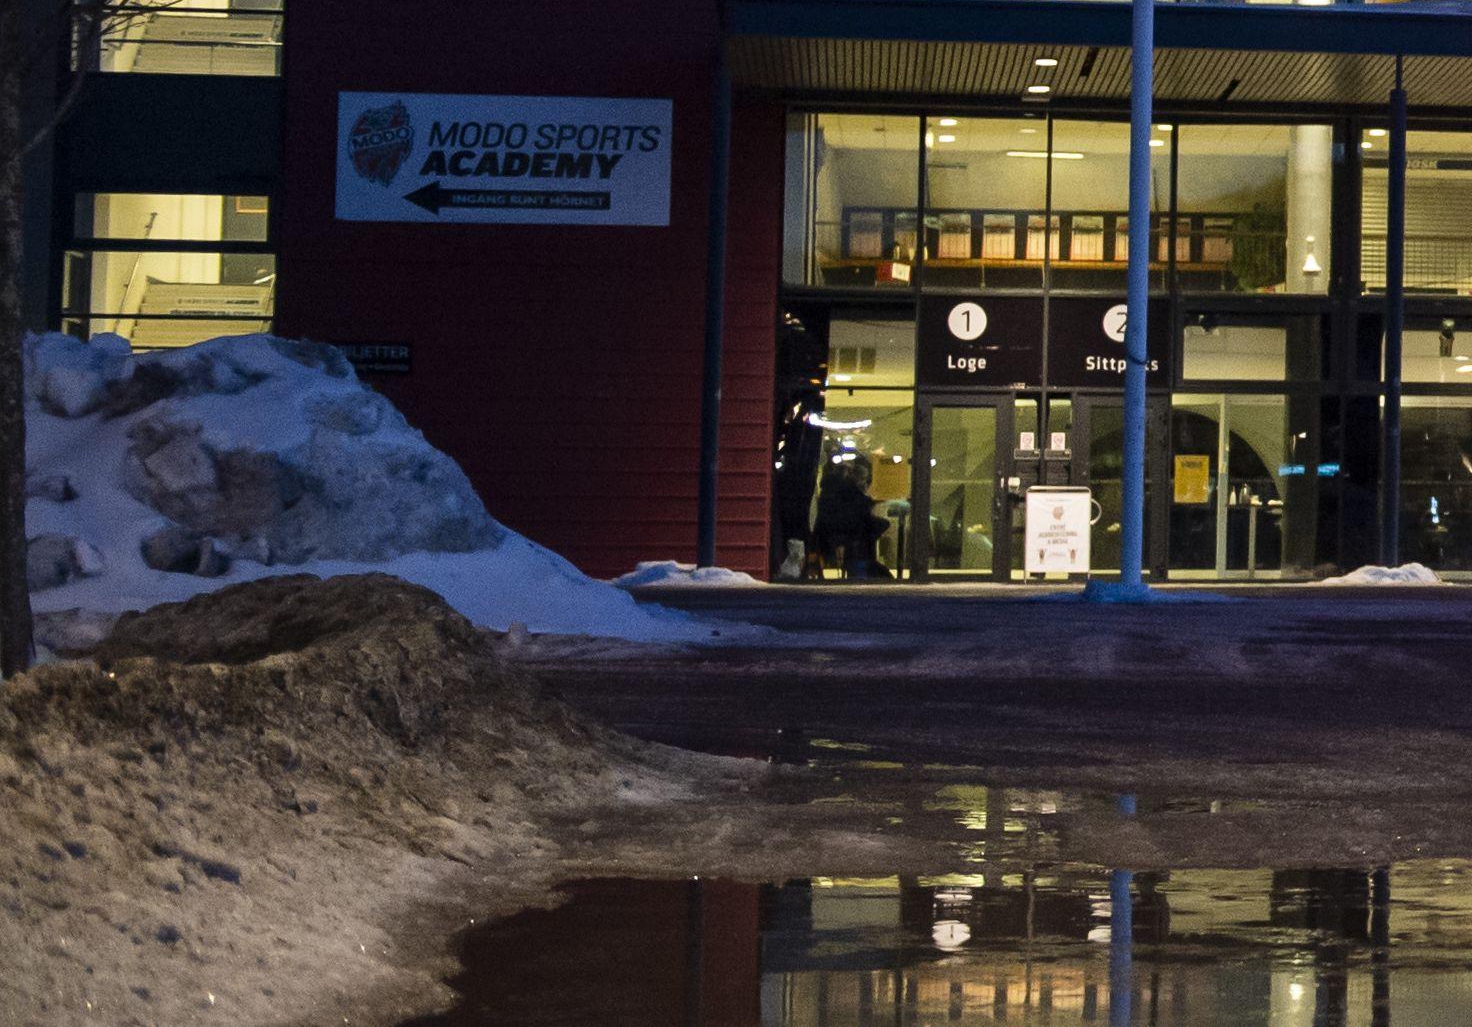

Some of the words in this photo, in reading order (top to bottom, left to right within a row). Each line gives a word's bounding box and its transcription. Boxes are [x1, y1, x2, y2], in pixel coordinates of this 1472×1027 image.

[428, 123, 527, 149] MODO
[533, 125, 661, 152] SPORTS
[419, 151, 623, 179] ACADEMY
[961, 310, 970, 332] 1
[947, 355, 987, 373] Loge
